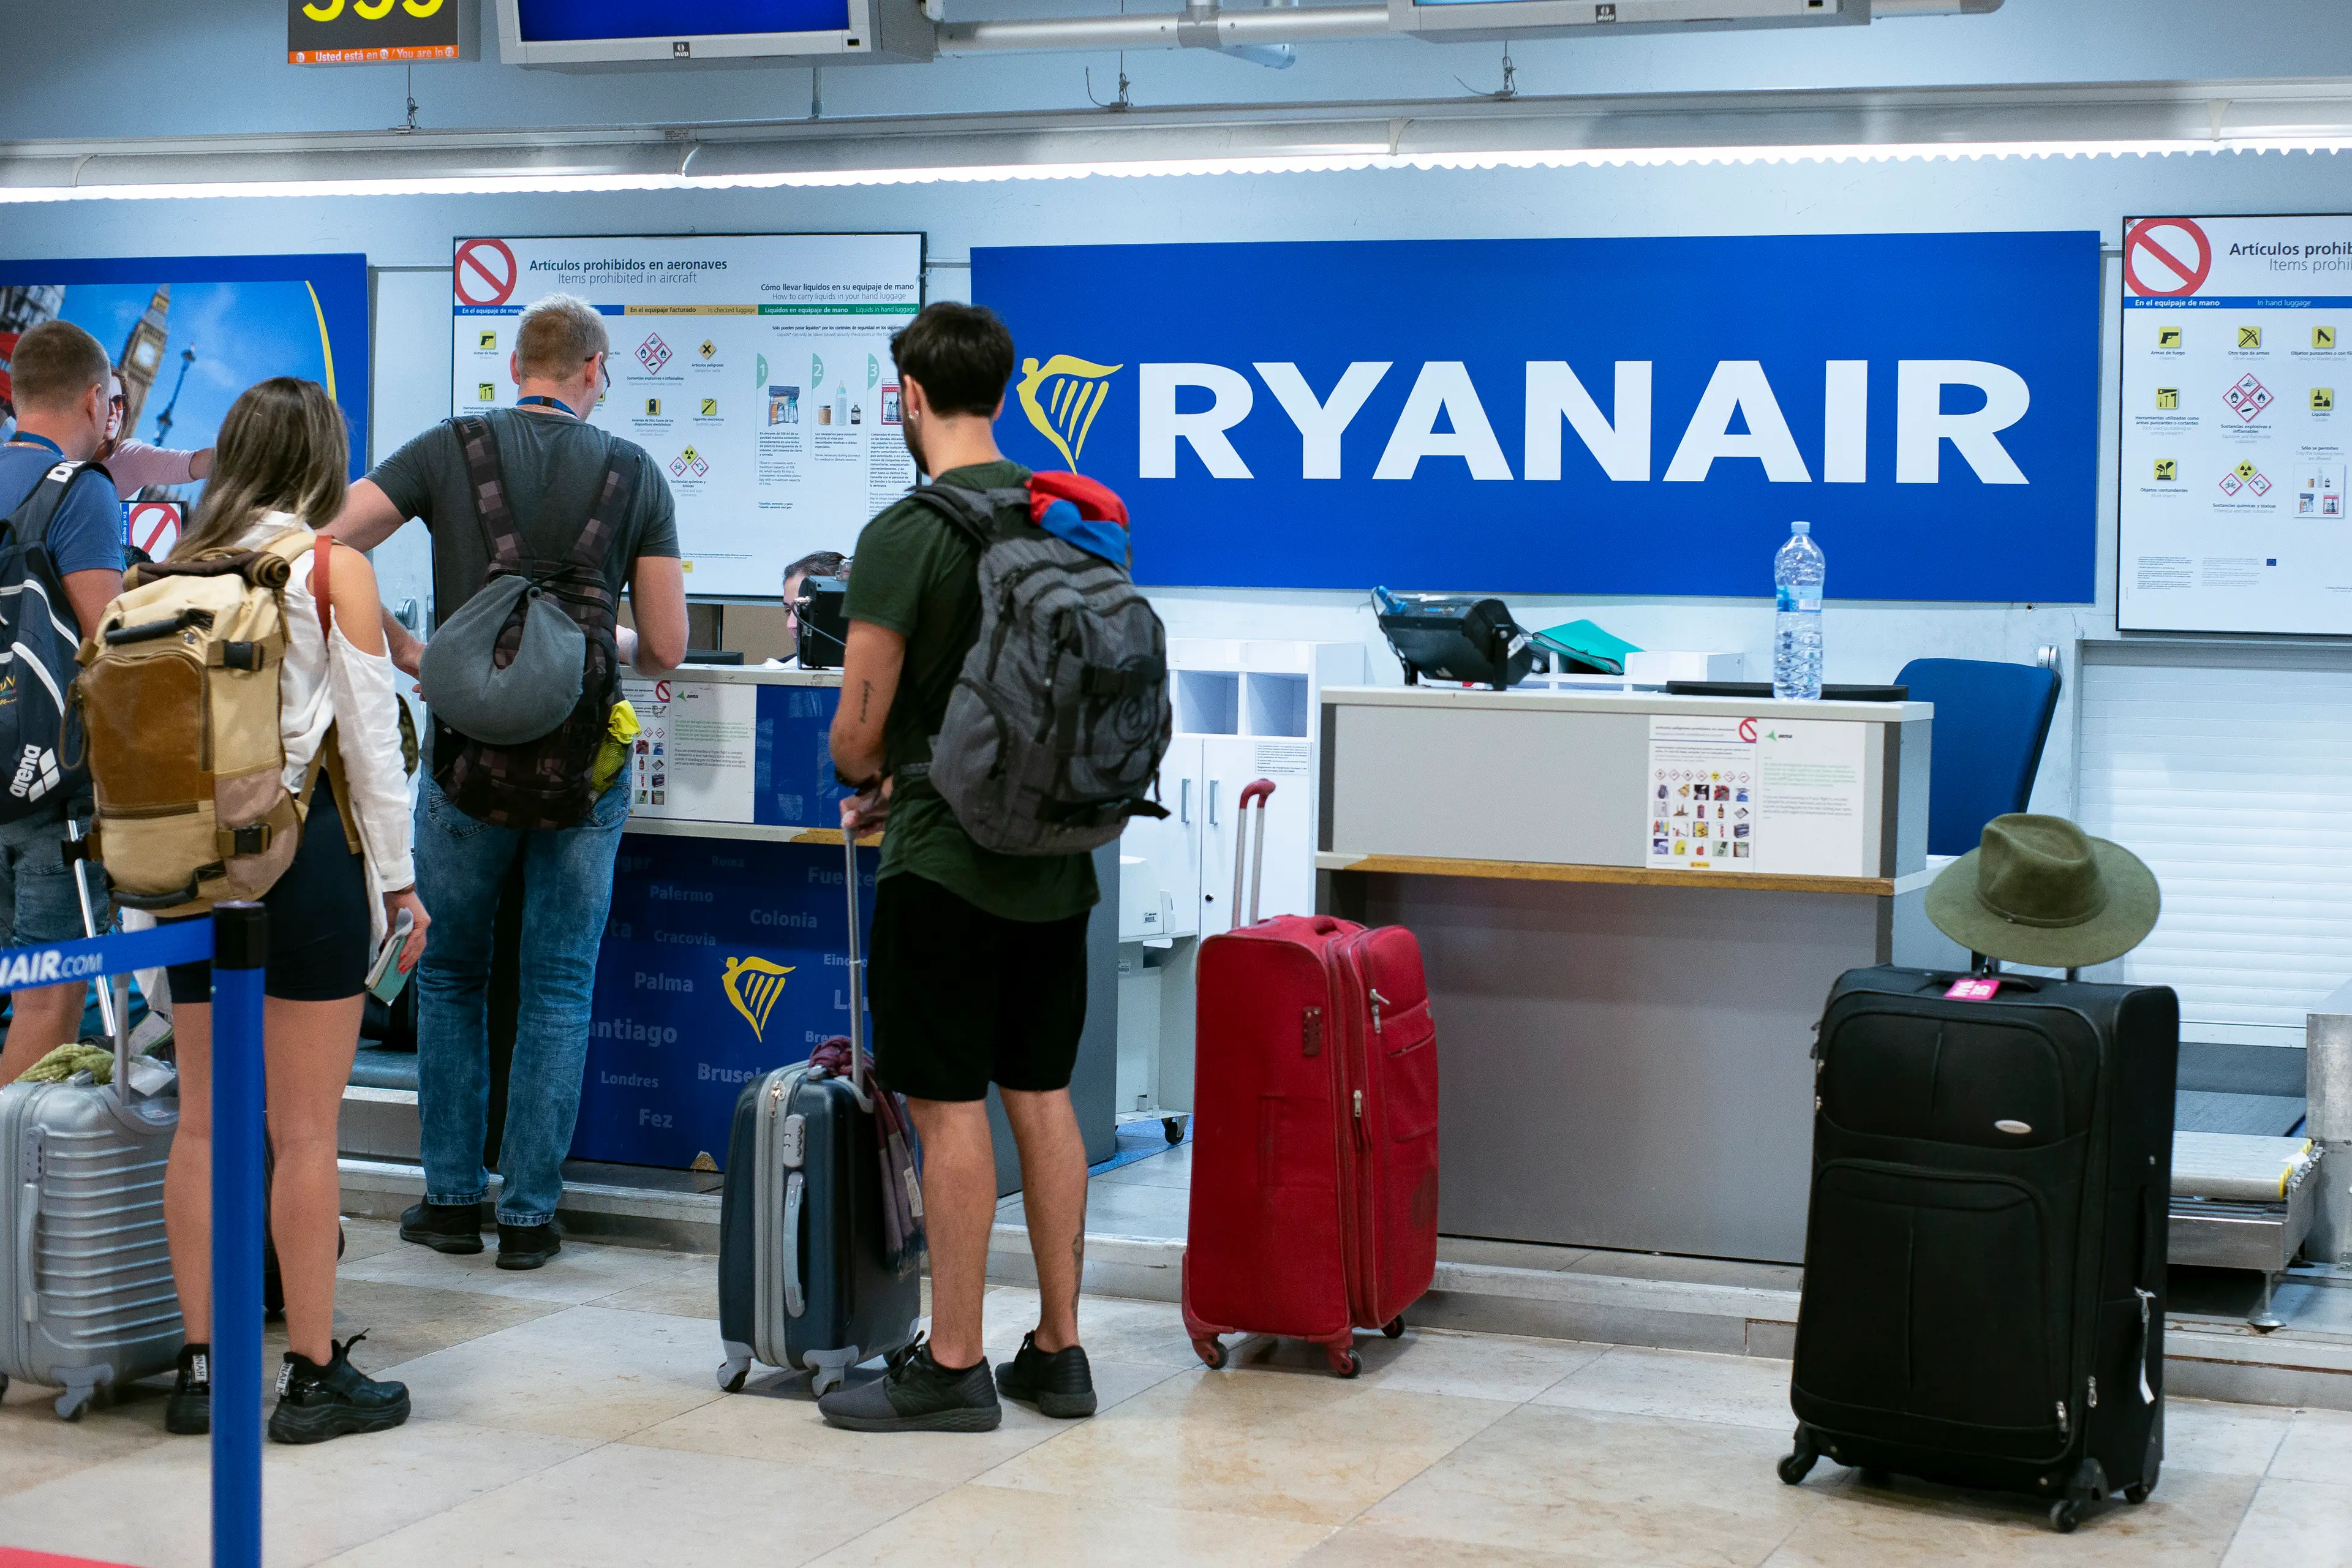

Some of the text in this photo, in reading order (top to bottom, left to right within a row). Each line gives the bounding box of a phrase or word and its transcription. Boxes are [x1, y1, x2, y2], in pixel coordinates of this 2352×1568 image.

[315, 51, 341, 61] Usted
[344, 50, 363, 60] está
[397, 49, 413, 58] You
[435, 47, 443, 57] in
[2230, 243, 2302, 255] Artículos
[529, 260, 580, 270] Artículos
[584, 259, 646, 273] prohibidos
[667, 260, 727, 270] aeronaves
[2269, 258, 2307, 271] Items
[559, 272, 697, 286] Items prohibited in aircraft
[760, 364, 765, 376] 1
[814, 364, 822, 377] 2
[869, 364, 878, 377] 3
[1139, 360, 2030, 484] RYANAIR
[9, 744, 41, 797] arena
[649, 885, 714, 902] Palermo
[750, 909, 818, 928] Colonia
[654, 930, 716, 946] Cracovia
[635, 971, 693, 992] Palma
[601, 1071, 659, 1088] Londres
[639, 1109, 673, 1128] Fez
